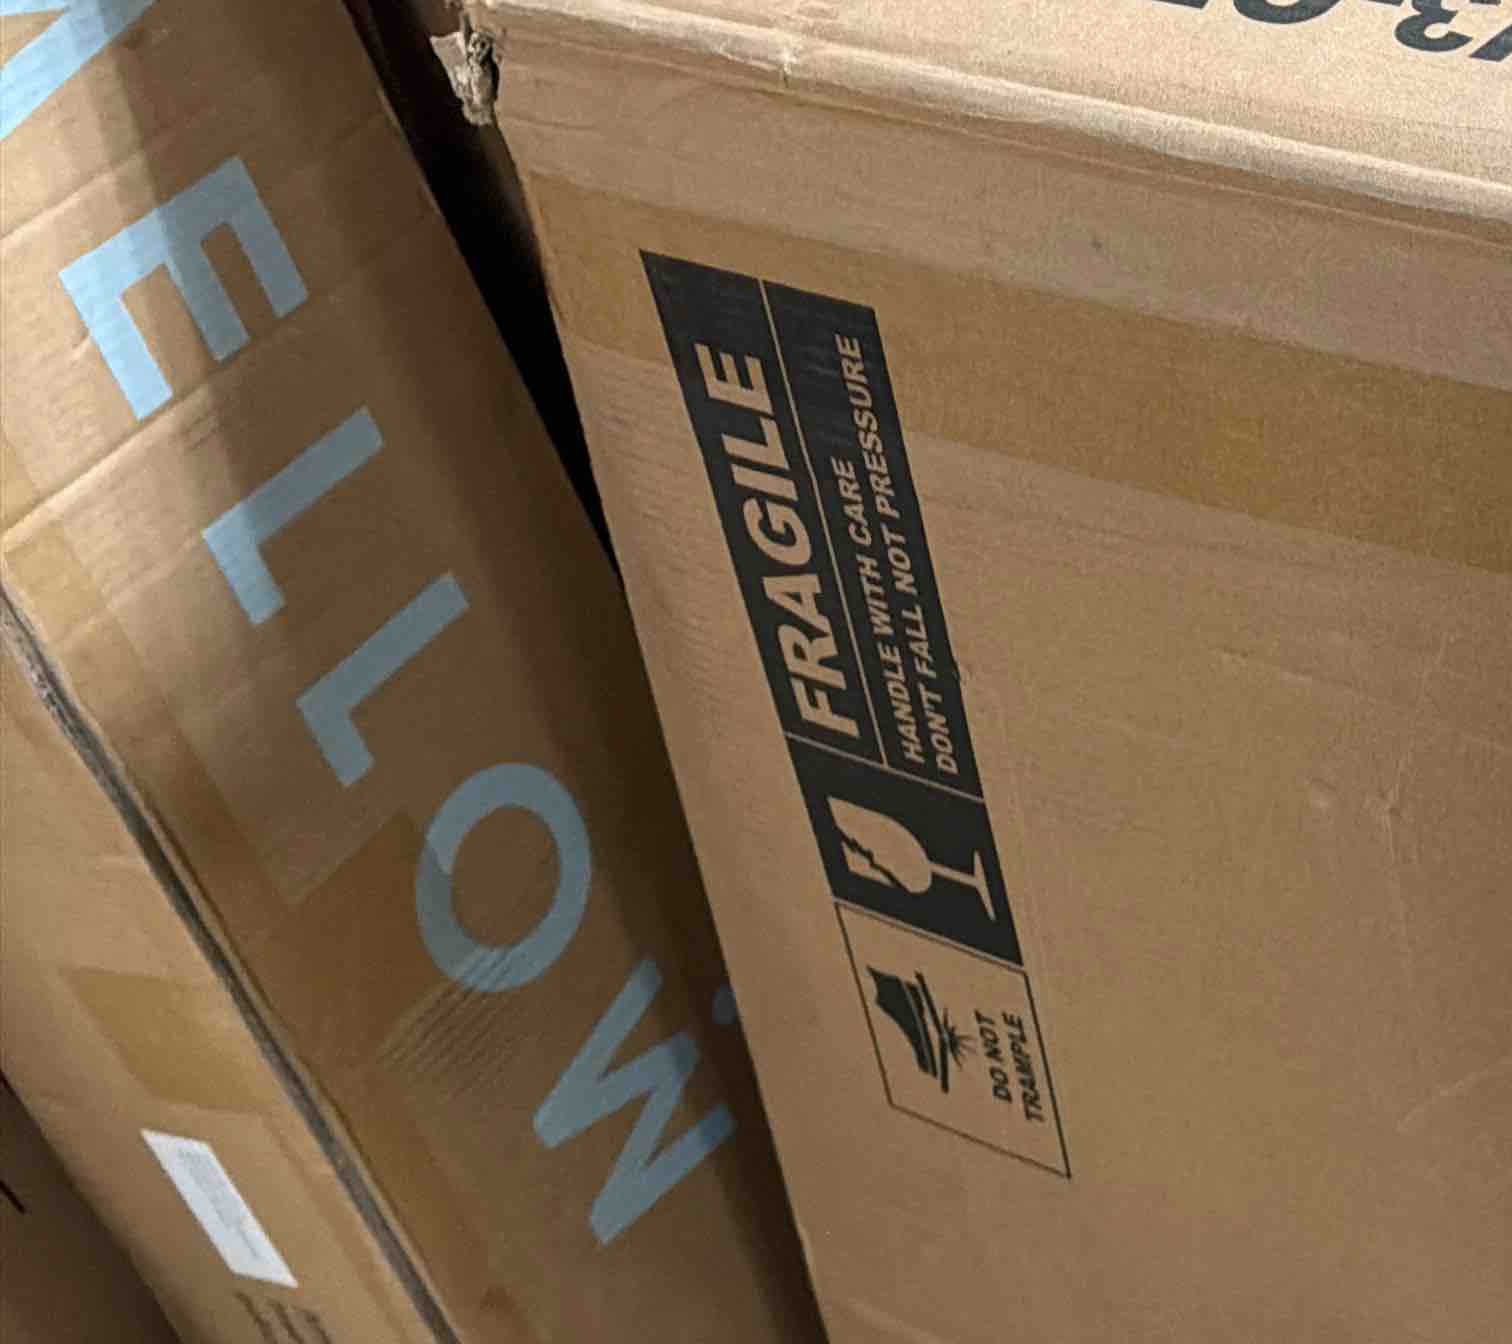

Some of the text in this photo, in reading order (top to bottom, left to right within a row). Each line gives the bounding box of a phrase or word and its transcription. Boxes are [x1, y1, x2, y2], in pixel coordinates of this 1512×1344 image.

[695, 343, 859, 739] FRAGILE
[832, 457, 925, 764] HANDLE WITH CARE
[835, 333, 959, 775] DON'T FALL NOT PRESSURE
[974, 1010, 1013, 1103] DO NOT
[1002, 1012, 1044, 1123] TRAMPLE
